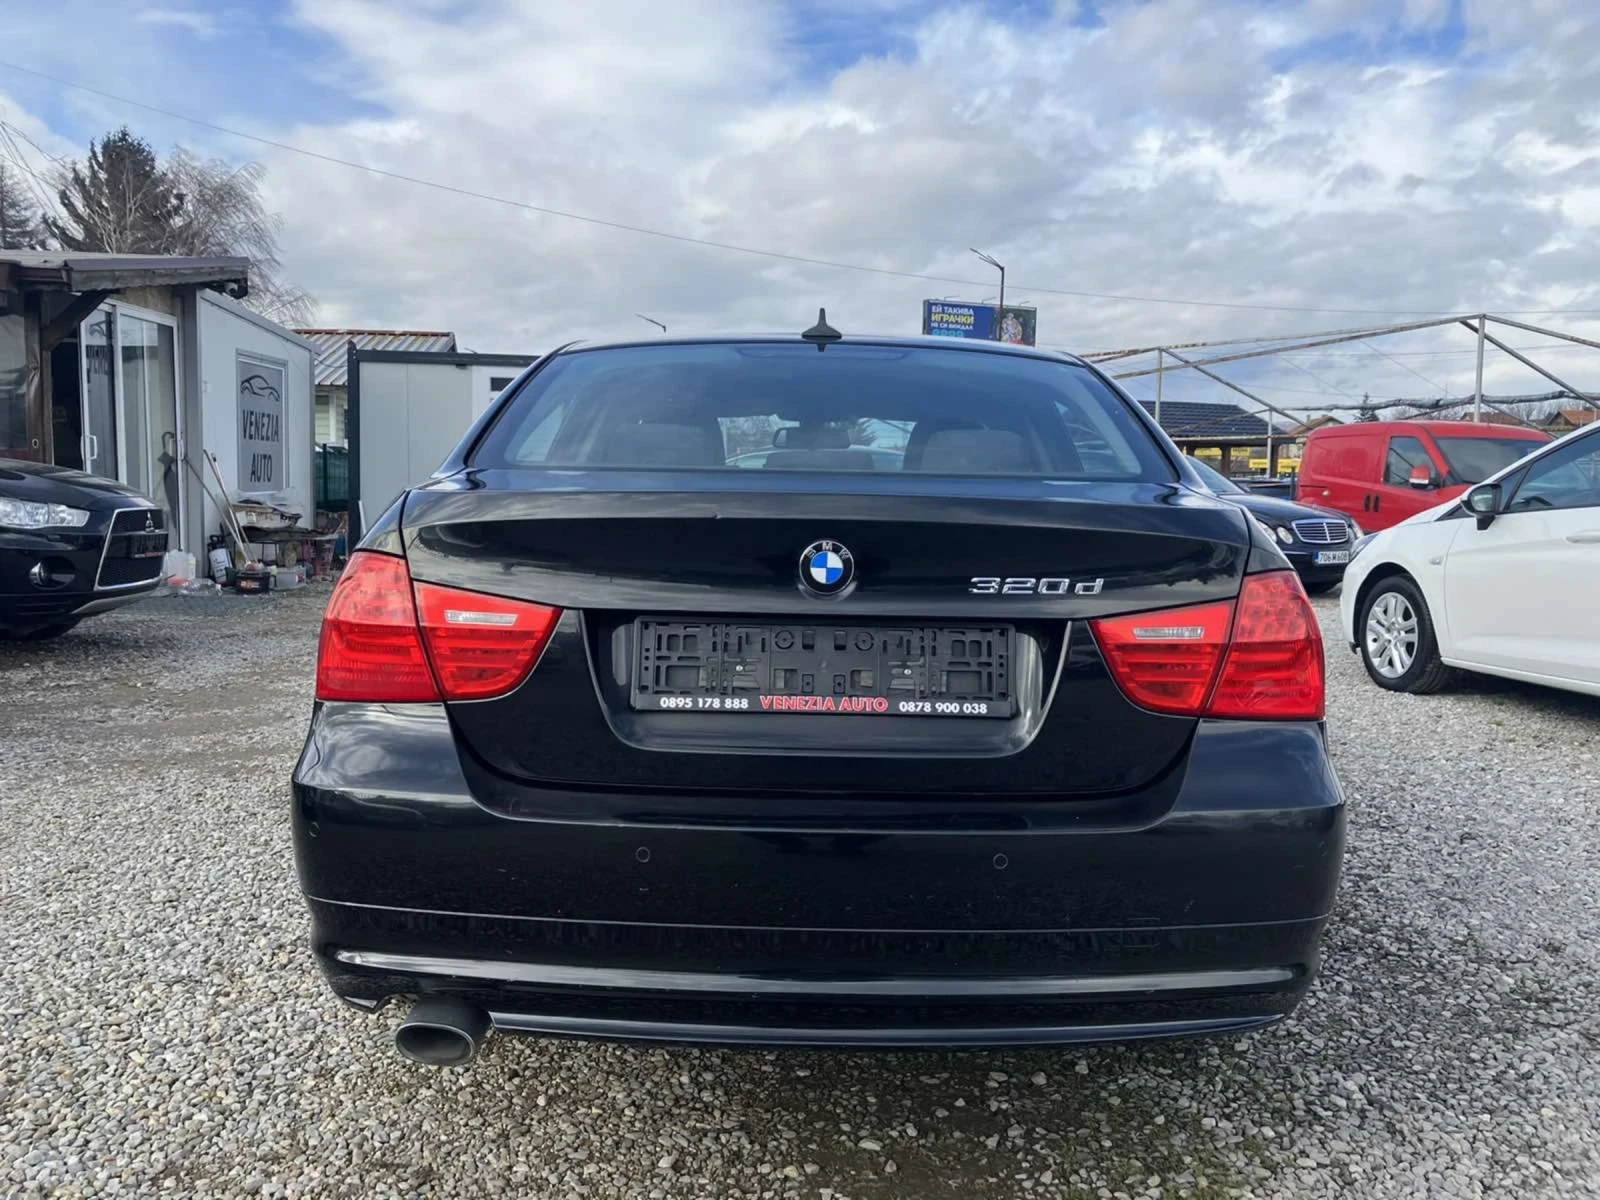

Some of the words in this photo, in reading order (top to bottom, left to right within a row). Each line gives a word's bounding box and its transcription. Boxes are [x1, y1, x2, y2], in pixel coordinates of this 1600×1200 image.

[931, 313, 975, 324] ИГРАЧКИ
[944, 306, 974, 315] ТАКИВА
[242, 409, 280, 443] VENEZIA
[249, 453, 273, 483] AUTO
[968, 577, 1105, 595] 320d
[659, 697, 693, 709] 0895
[697, 698, 721, 709] 178
[724, 698, 749, 709] 888
[759, 695, 836, 711] VENEZIA
[838, 697, 889, 712] AUTO
[899, 701, 932, 713] 0878
[935, 701, 960, 714] 900
[963, 703, 988, 715] 038
